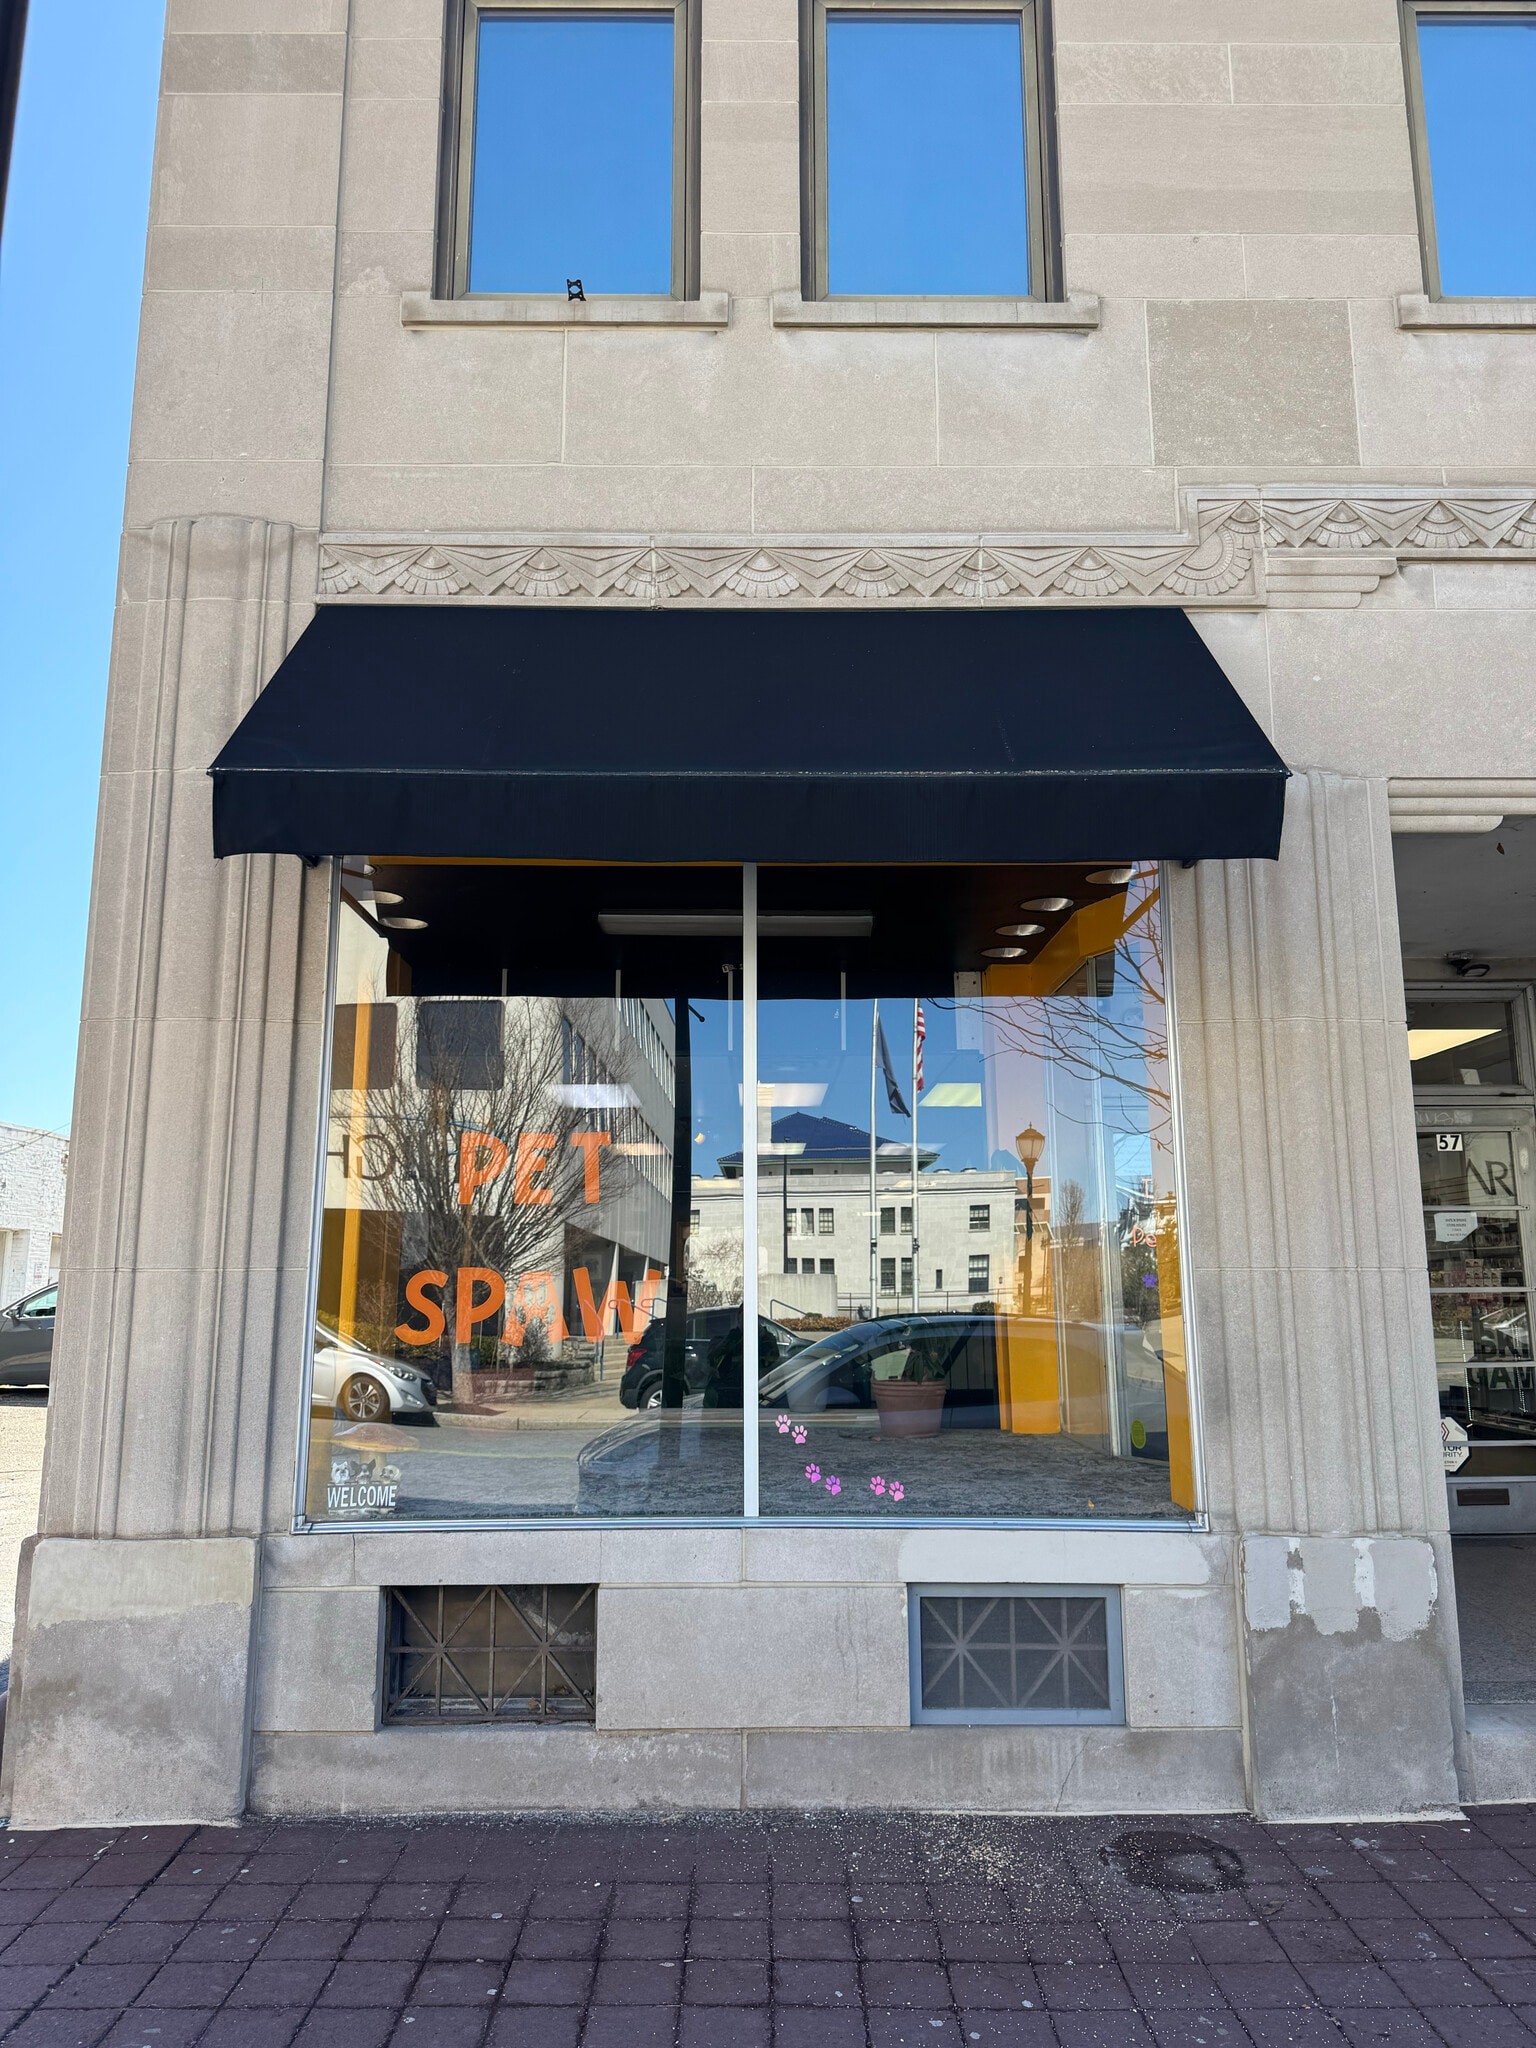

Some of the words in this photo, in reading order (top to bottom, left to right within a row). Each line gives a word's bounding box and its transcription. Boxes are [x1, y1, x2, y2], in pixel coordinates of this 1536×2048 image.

[1438, 1134, 1460, 1150] 57
[457, 1131, 611, 1205] PET
[1132, 1225, 1157, 1248] Pe
[394, 1266, 663, 1347] SPAW
[327, 1485, 398, 1508] WELCOME
